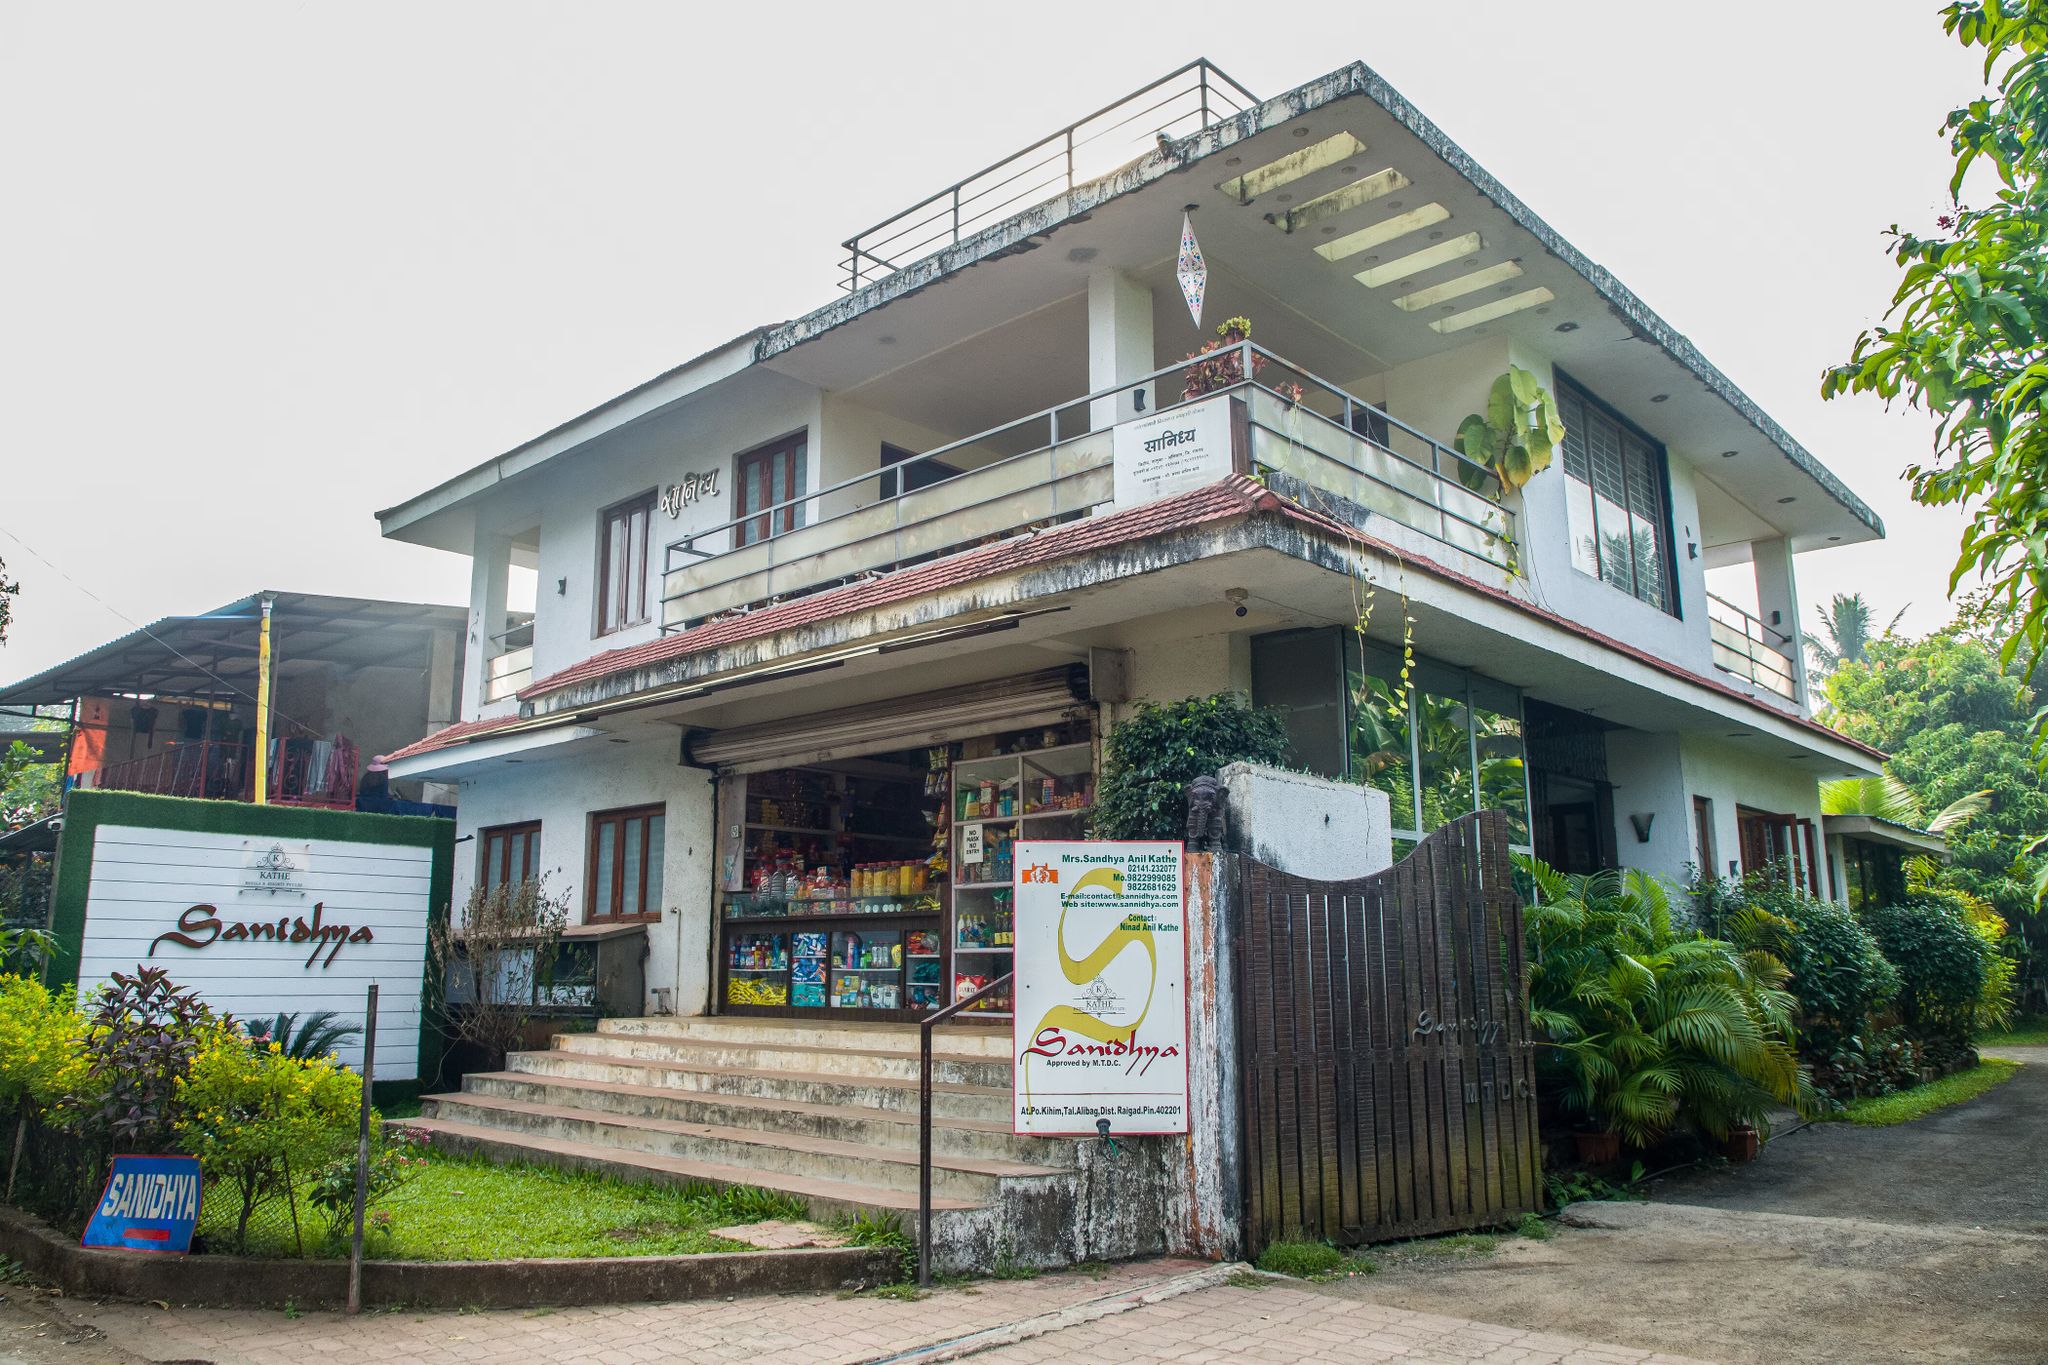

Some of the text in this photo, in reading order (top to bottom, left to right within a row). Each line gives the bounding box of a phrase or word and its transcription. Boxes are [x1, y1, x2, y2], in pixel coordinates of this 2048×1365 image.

[1144, 428, 1197, 453] सानिध्य
[1062, 854, 1177, 864] Mrs.Sandhya Anil Kathe
[260, 871, 291, 880] KATHE
[1113, 873, 1177, 882] Mo.9822999085
[1127, 883, 1177, 892] 9822681629
[1119, 922, 1179, 932] Ninad Anil Kathe
[149, 901, 374, 970] Sanidhya
[1086, 1000, 1114, 1008] KATHE
[1019, 1027, 1179, 1077] Sanidhya
[1046, 1059, 1081, 1068] Approved
[1081, 1060, 1090, 1068] by
[101, 1173, 197, 1221] SANIDHYA
